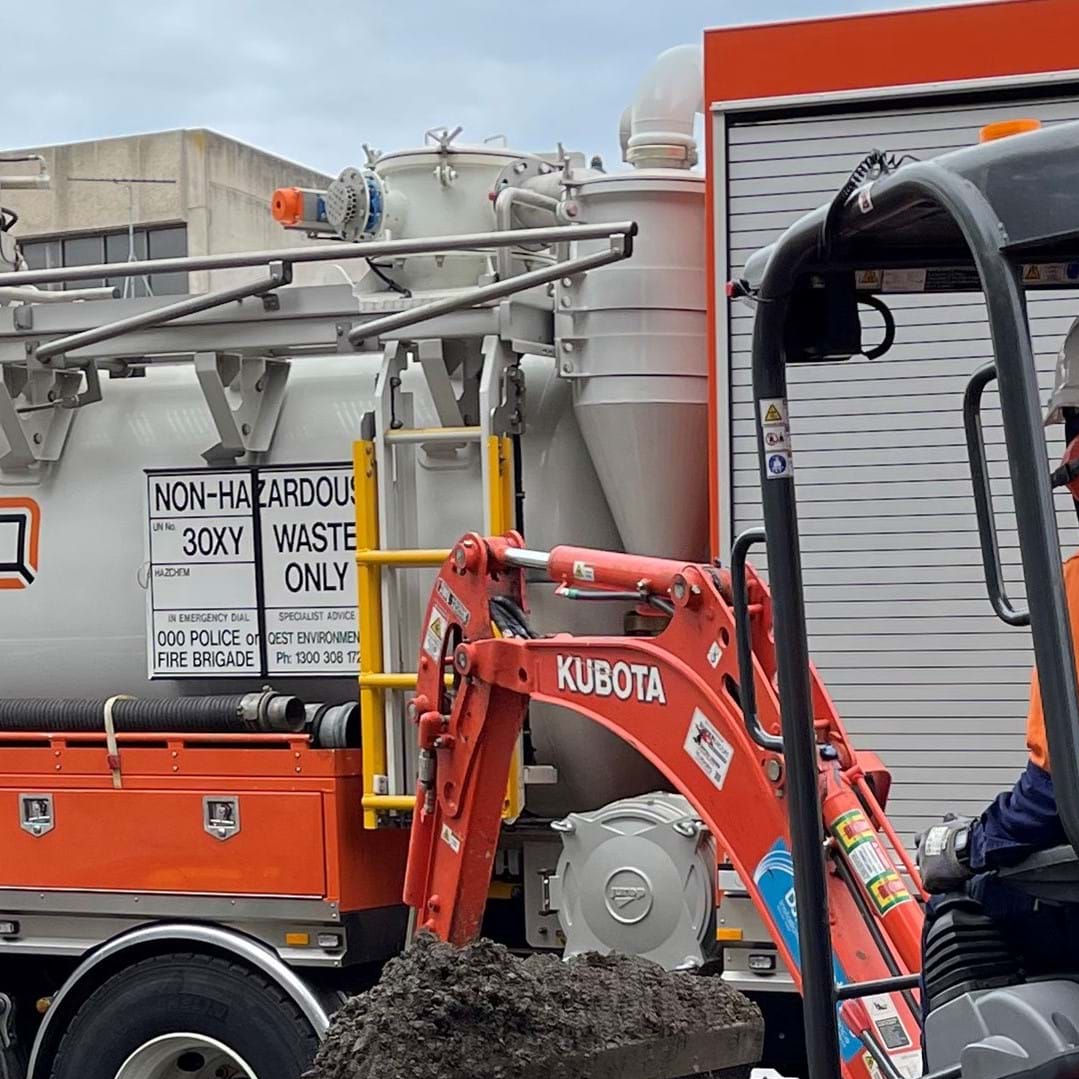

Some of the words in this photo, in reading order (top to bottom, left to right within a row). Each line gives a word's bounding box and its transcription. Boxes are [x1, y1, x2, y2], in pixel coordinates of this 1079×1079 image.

[273, 522, 357, 553] WASTE
[154, 568, 190, 577] HAZCHEM
[285, 562, 349, 593] ONLY
[168, 615, 177, 623] IN
[179, 613, 229, 622] EMERGENCY
[231, 613, 250, 622] DIAL
[279, 611, 324, 621] SPECIALIST
[327, 611, 356, 620] ADVICE
[157, 630, 185, 647] 000
[190, 629, 241, 647] POLICE
[246, 633, 260, 647] or
[158, 652, 188, 668] FIRE
[193, 650, 254, 667] BRIGADE
[296, 651, 320, 664] 1300
[556, 654, 667, 704] KUBOTA
